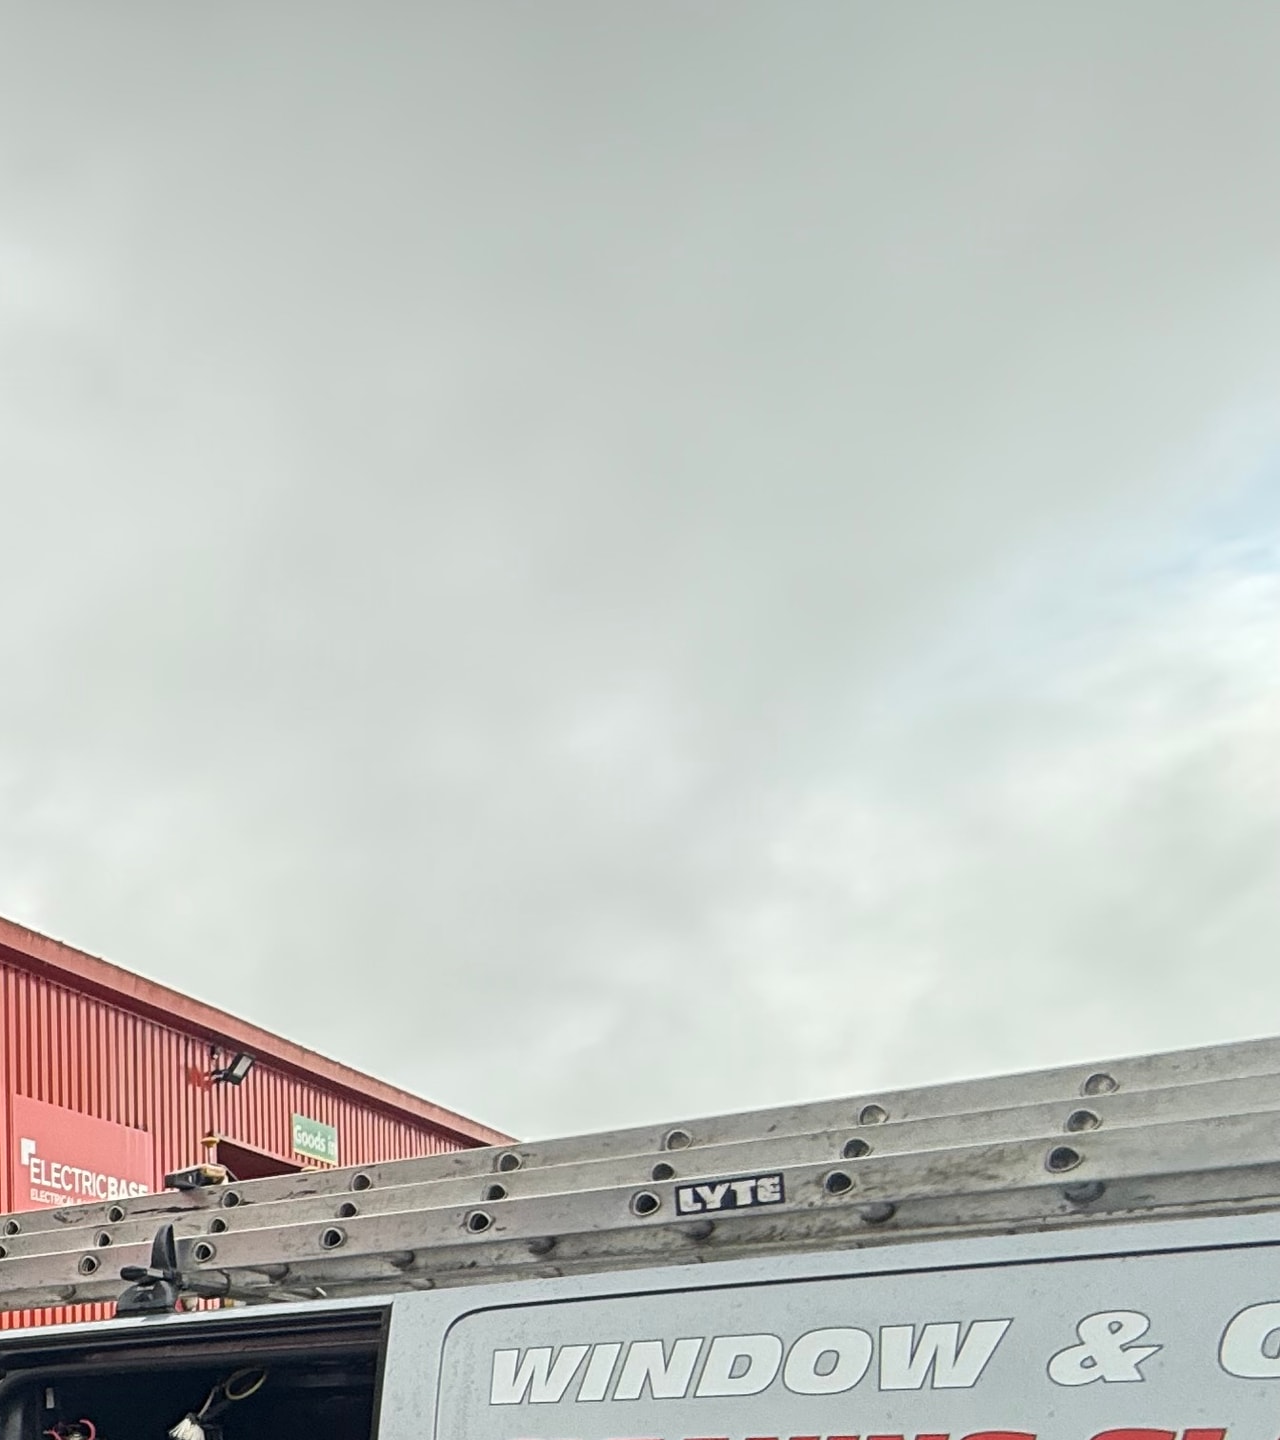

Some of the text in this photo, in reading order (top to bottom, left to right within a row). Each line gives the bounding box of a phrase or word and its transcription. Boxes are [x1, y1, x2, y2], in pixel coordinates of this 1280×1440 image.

[294, 1125, 326, 1153] Goods
[679, 1176, 781, 1212] LYTE
[490, 1318, 1014, 1406] WINDOW
[1047, 1309, 1163, 1387] &
